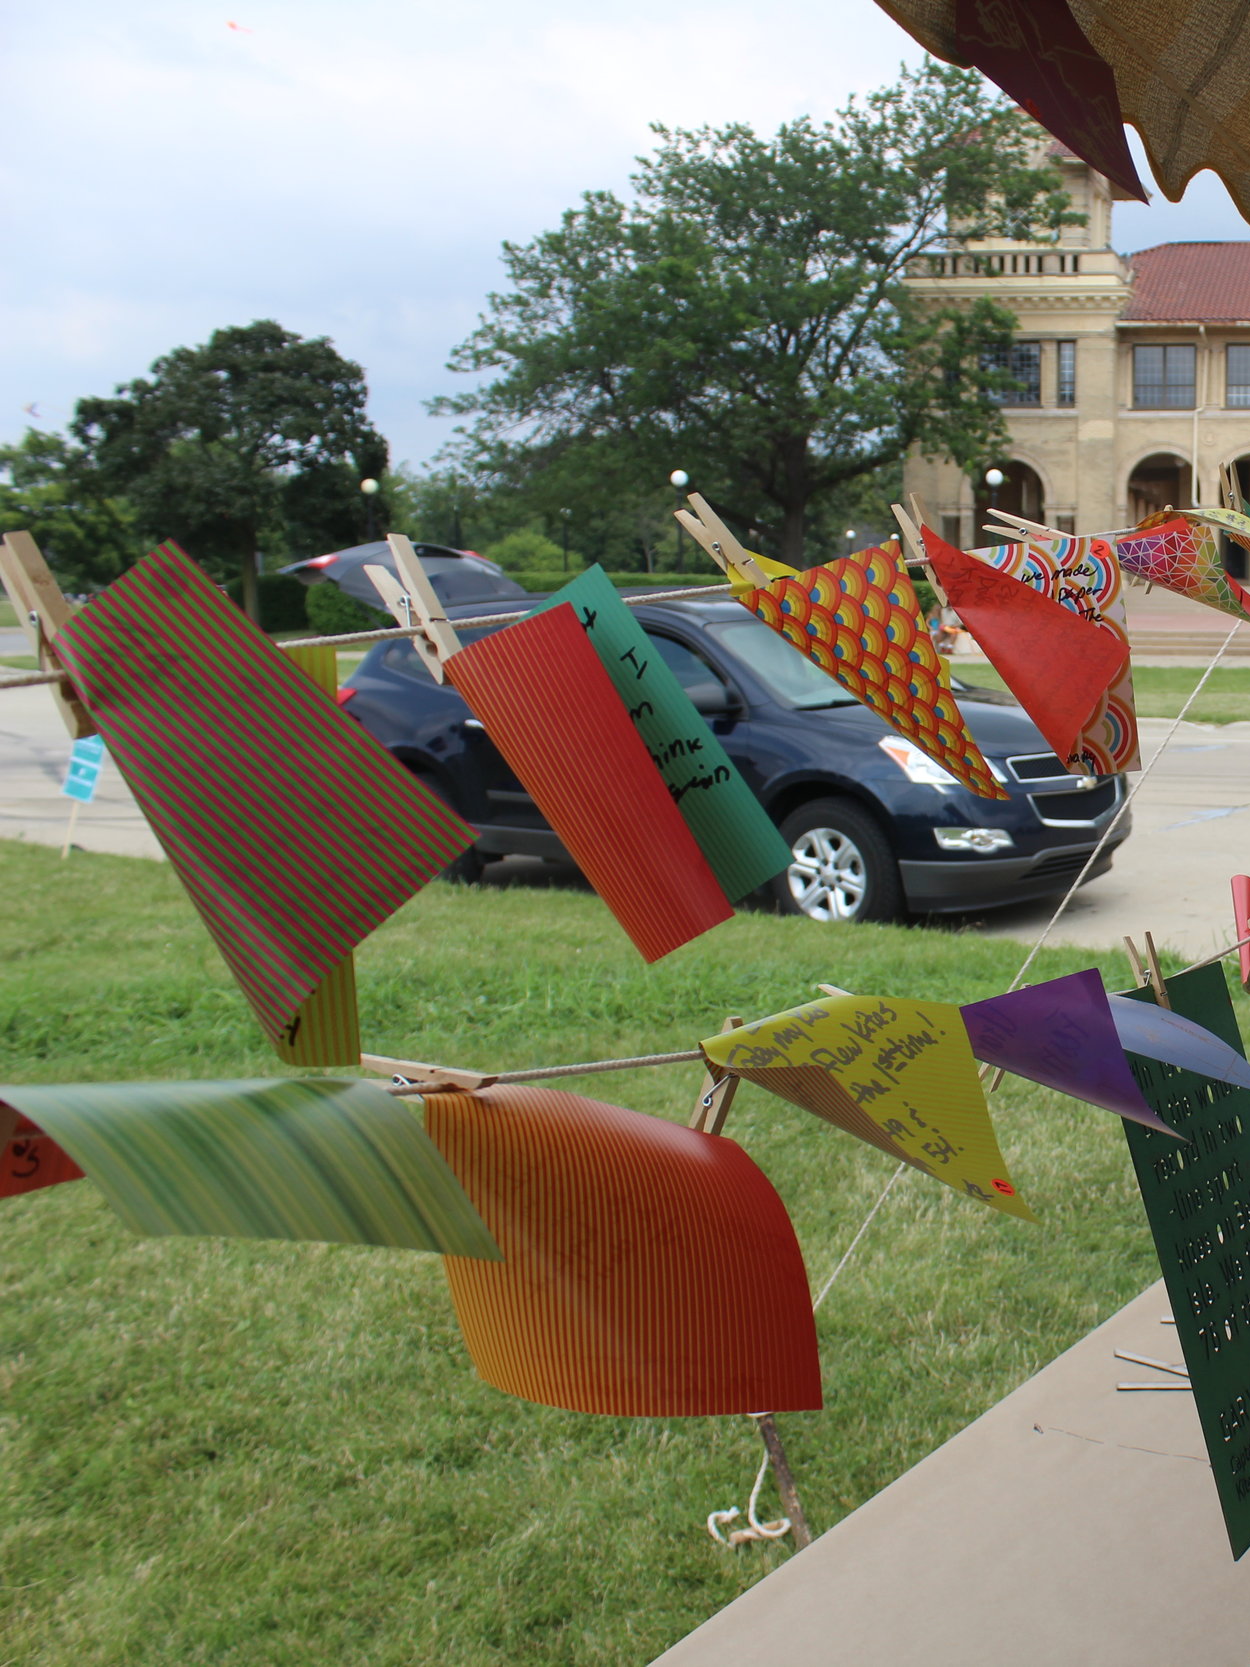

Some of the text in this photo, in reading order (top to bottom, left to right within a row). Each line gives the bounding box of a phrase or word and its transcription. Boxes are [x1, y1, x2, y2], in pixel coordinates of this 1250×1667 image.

[1051, 563, 1099, 580] made
[1058, 586, 1103, 605] paper
[772, 1022, 814, 1050] my
[1200, 1126, 1219, 1155] in
[1217, 1114, 1243, 1142] two
[1205, 1157, 1244, 1205] sport
[1175, 1231, 1214, 1274] kites
[1216, 1217, 1236, 1246] on
[1219, 1252, 1244, 1289] We
[1224, 1304, 1240, 1342] of
